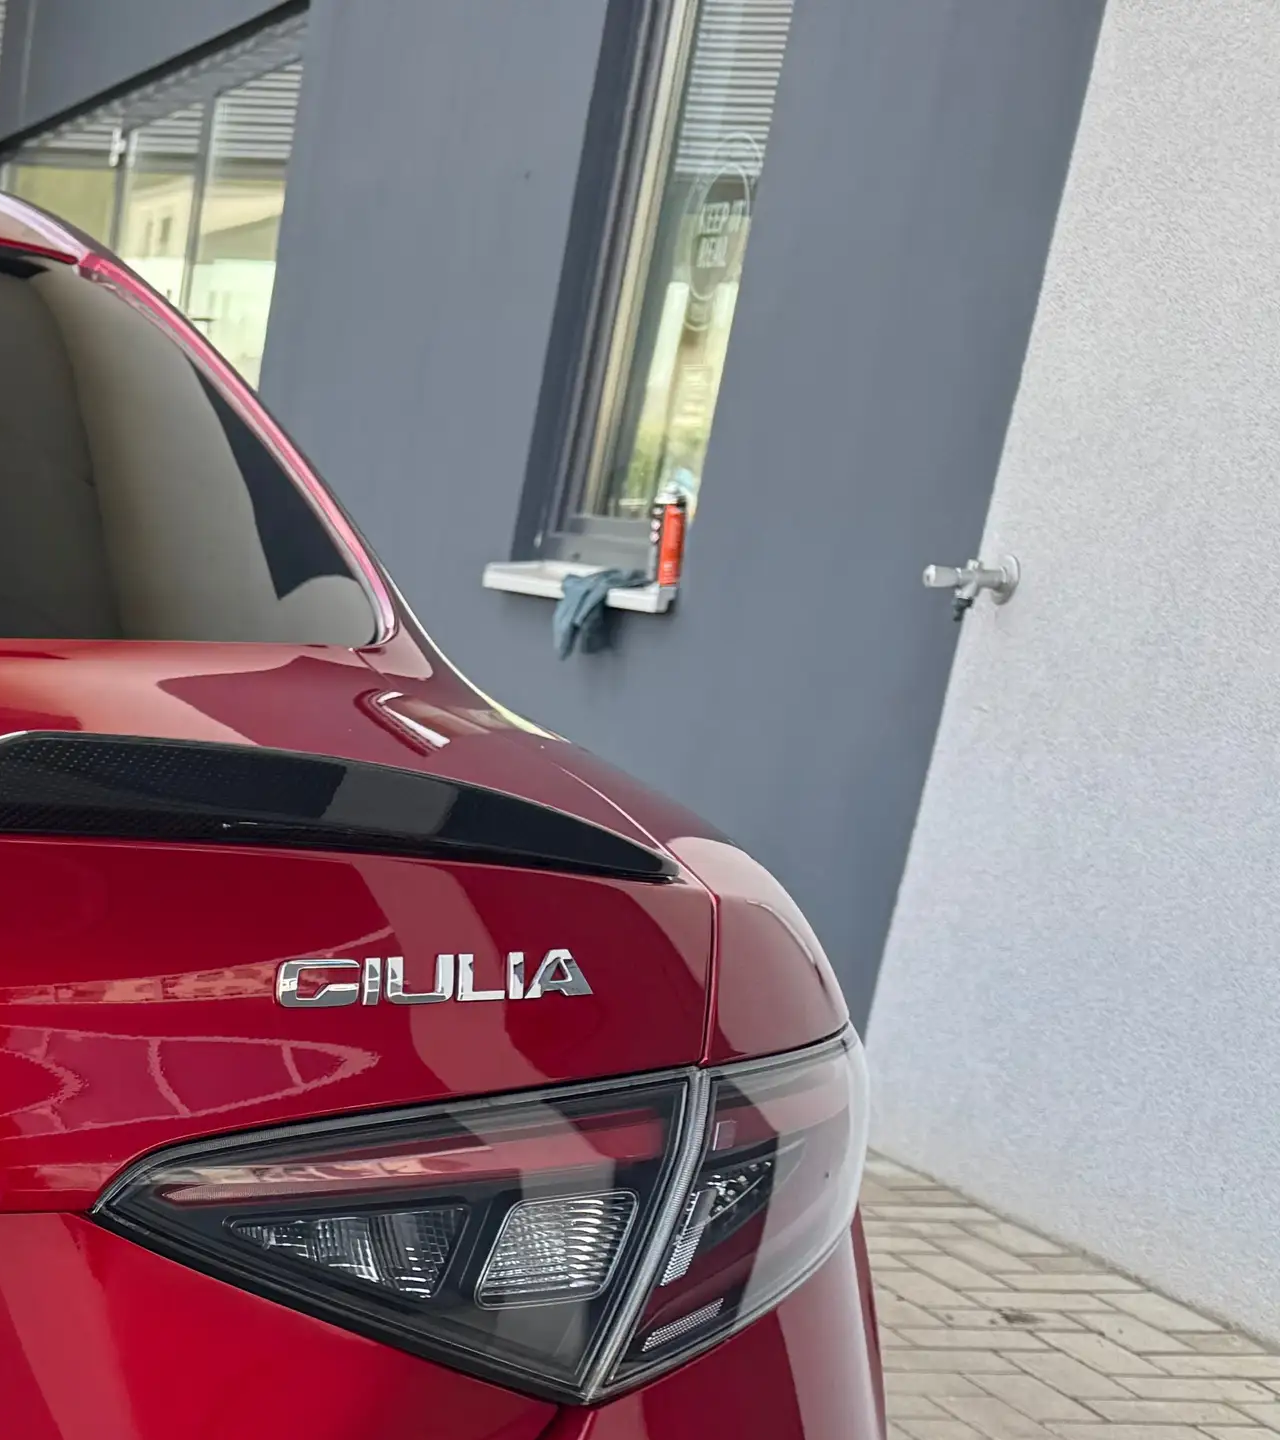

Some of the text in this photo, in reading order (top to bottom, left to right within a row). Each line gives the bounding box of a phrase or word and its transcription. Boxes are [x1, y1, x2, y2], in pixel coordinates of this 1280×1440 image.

[699, 201, 731, 234] KEEP
[696, 235, 728, 268] REAL
[275, 948, 593, 1008] GIULIA
